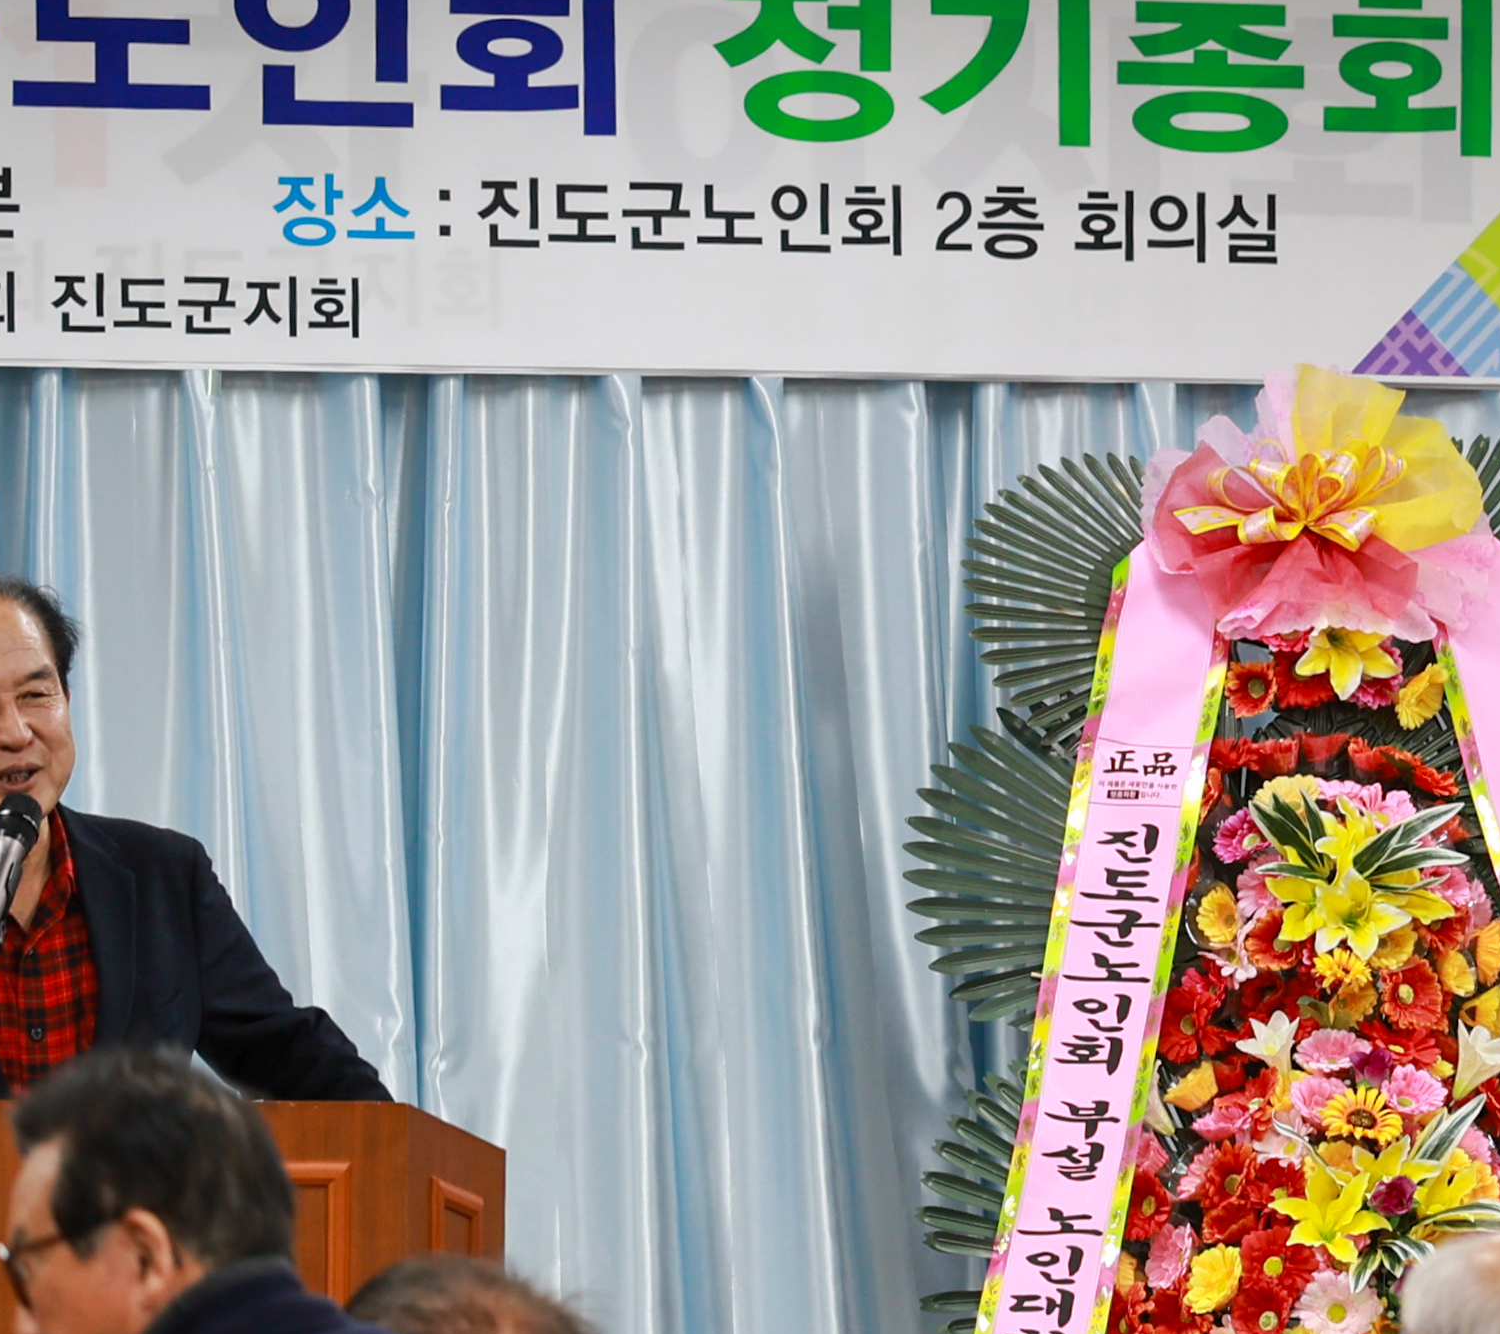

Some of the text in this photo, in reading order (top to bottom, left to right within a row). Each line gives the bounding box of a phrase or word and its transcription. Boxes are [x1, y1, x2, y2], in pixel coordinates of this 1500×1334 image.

[272, 172, 417, 248] 장소
[477, 177, 903, 256] 진도군노인회
[935, 186, 1046, 260] 2층
[1074, 191, 1279, 265] 회의실
[51, 272, 361, 338] 진도군지회
[1103, 750, 1178, 777] 正品
[1054, 823, 1161, 1076] 진도군노인회
[1041, 1099, 1121, 1182] 부설
